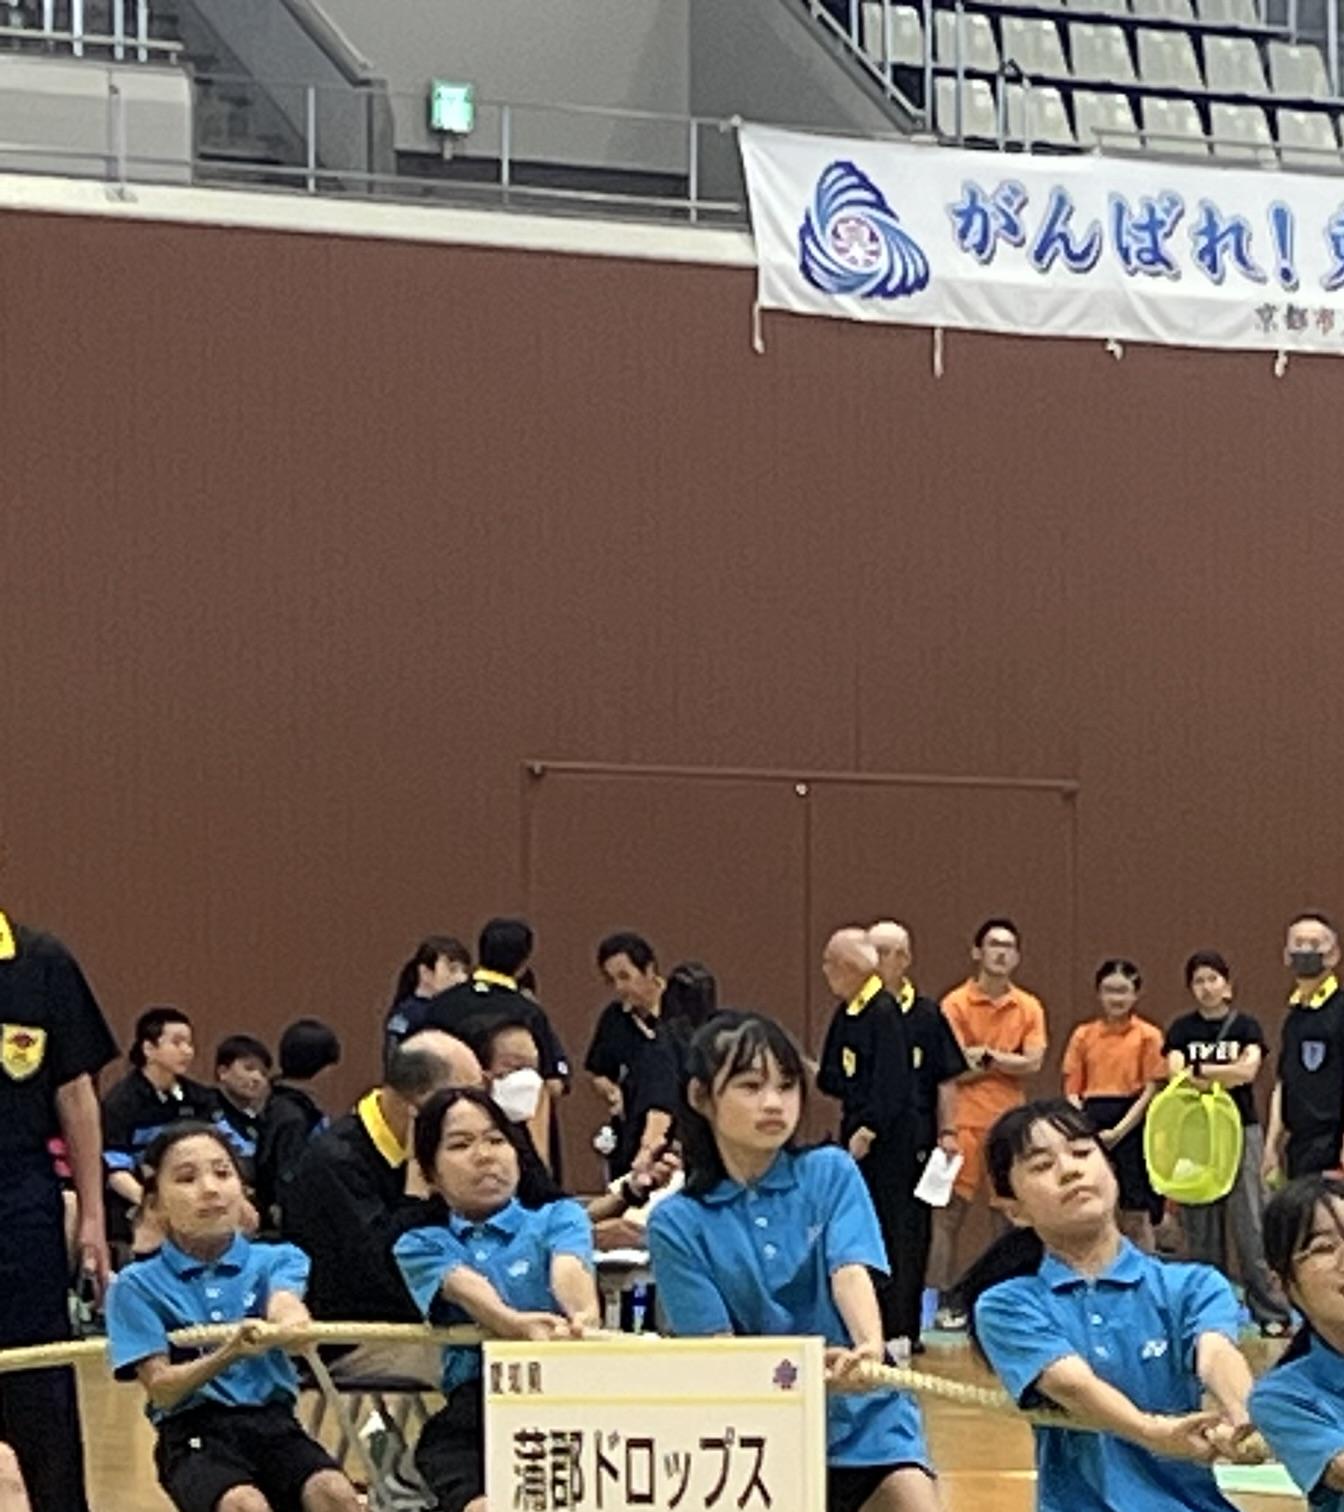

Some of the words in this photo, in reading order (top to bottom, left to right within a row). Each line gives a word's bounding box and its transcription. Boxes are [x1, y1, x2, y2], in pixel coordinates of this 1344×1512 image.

[513, 1427, 773, 1512] 蒲郡ドロップス
